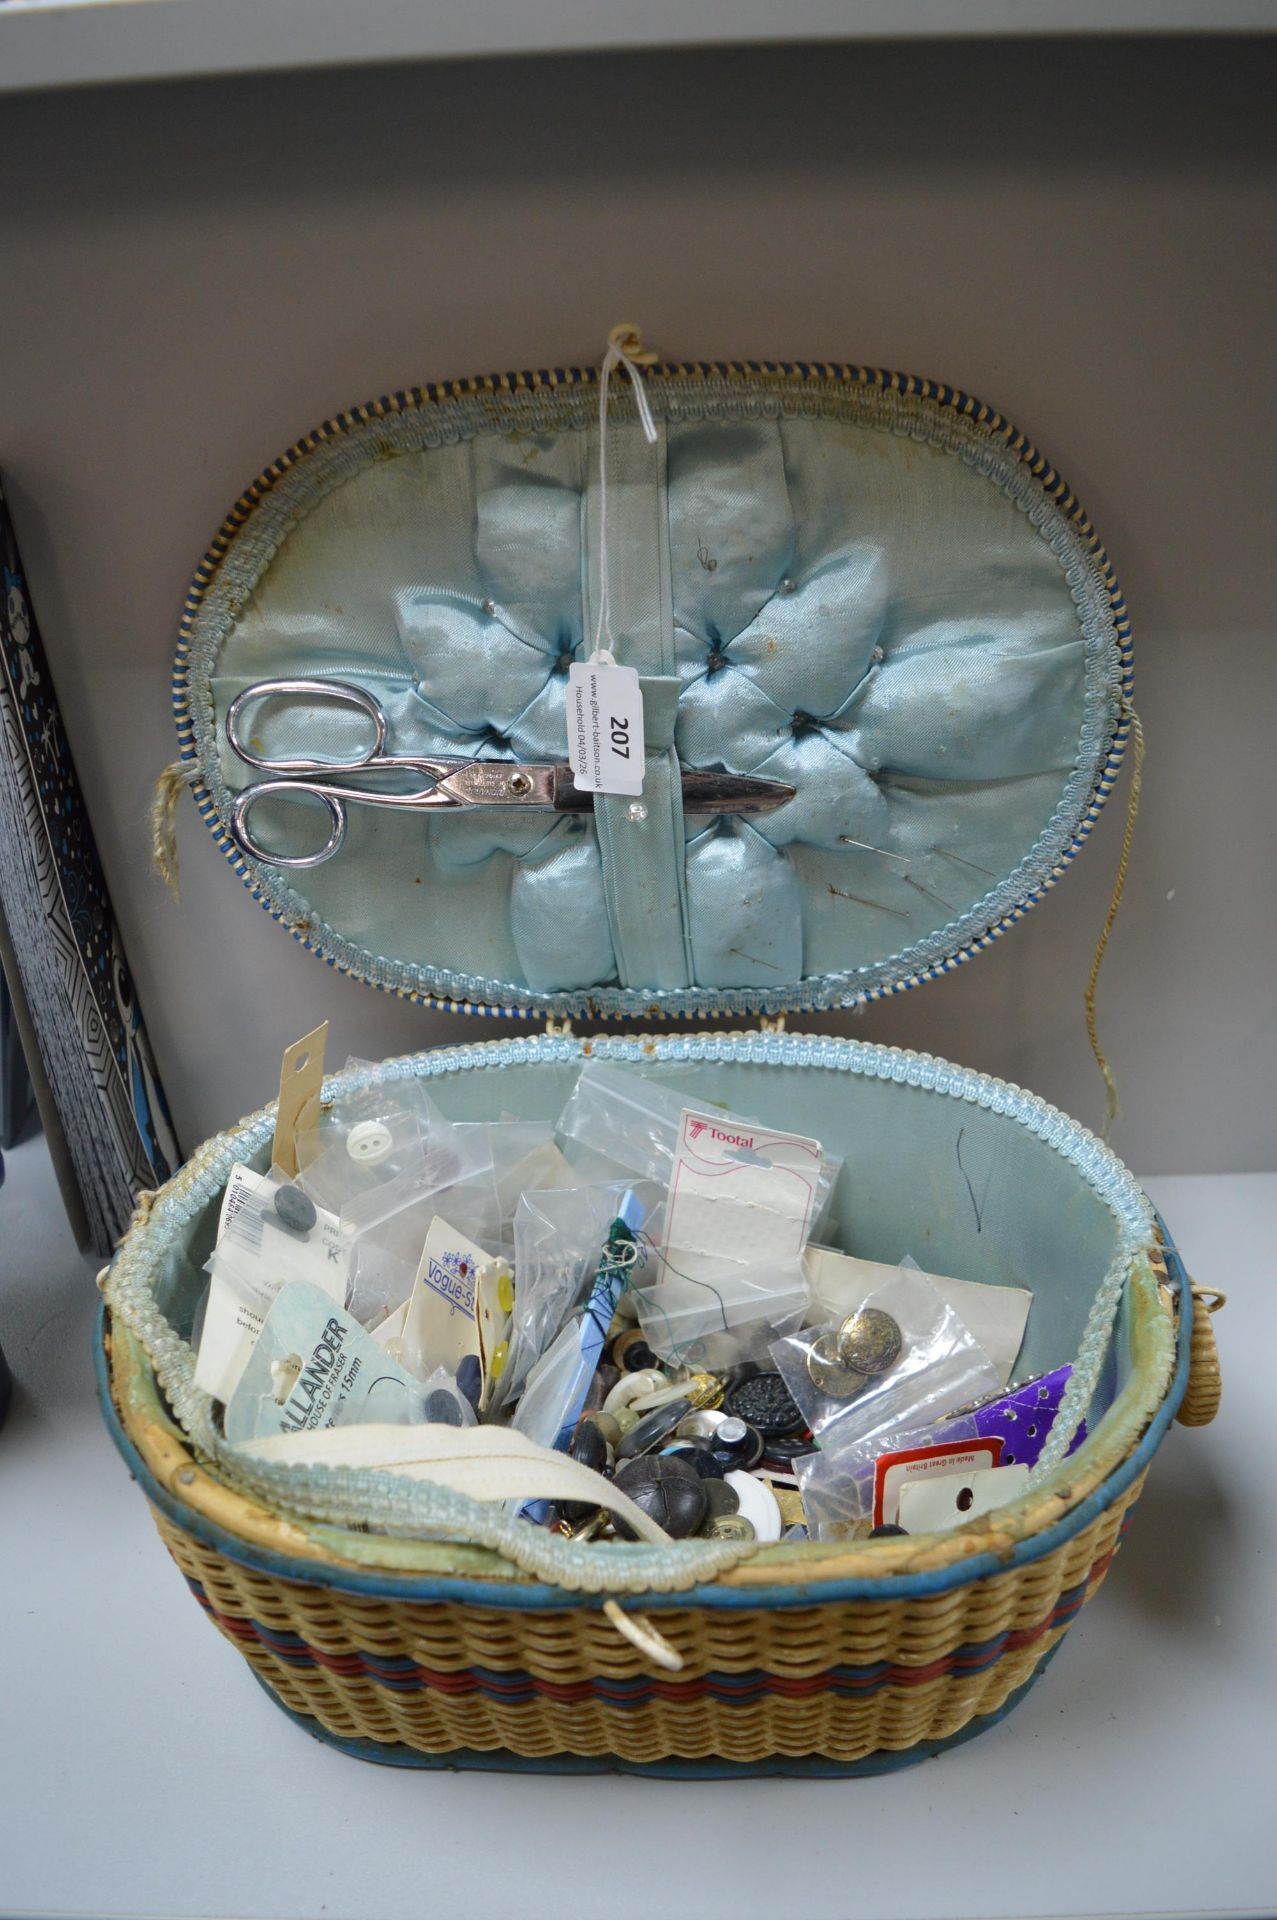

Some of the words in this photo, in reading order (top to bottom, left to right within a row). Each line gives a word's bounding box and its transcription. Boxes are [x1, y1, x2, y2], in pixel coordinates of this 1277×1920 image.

[575, 685, 586, 732] Household
[590, 673, 603, 789] www.gilbert-baitson.co.uk
[610, 716, 630, 760] 207
[577, 733, 588, 775] 04/03/26
[709, 1127, 754, 1149] Tootal
[322, 1384, 334, 1401] OF
[328, 1352, 348, 1388] FRASER
[340, 1356, 363, 1393] 15mm
